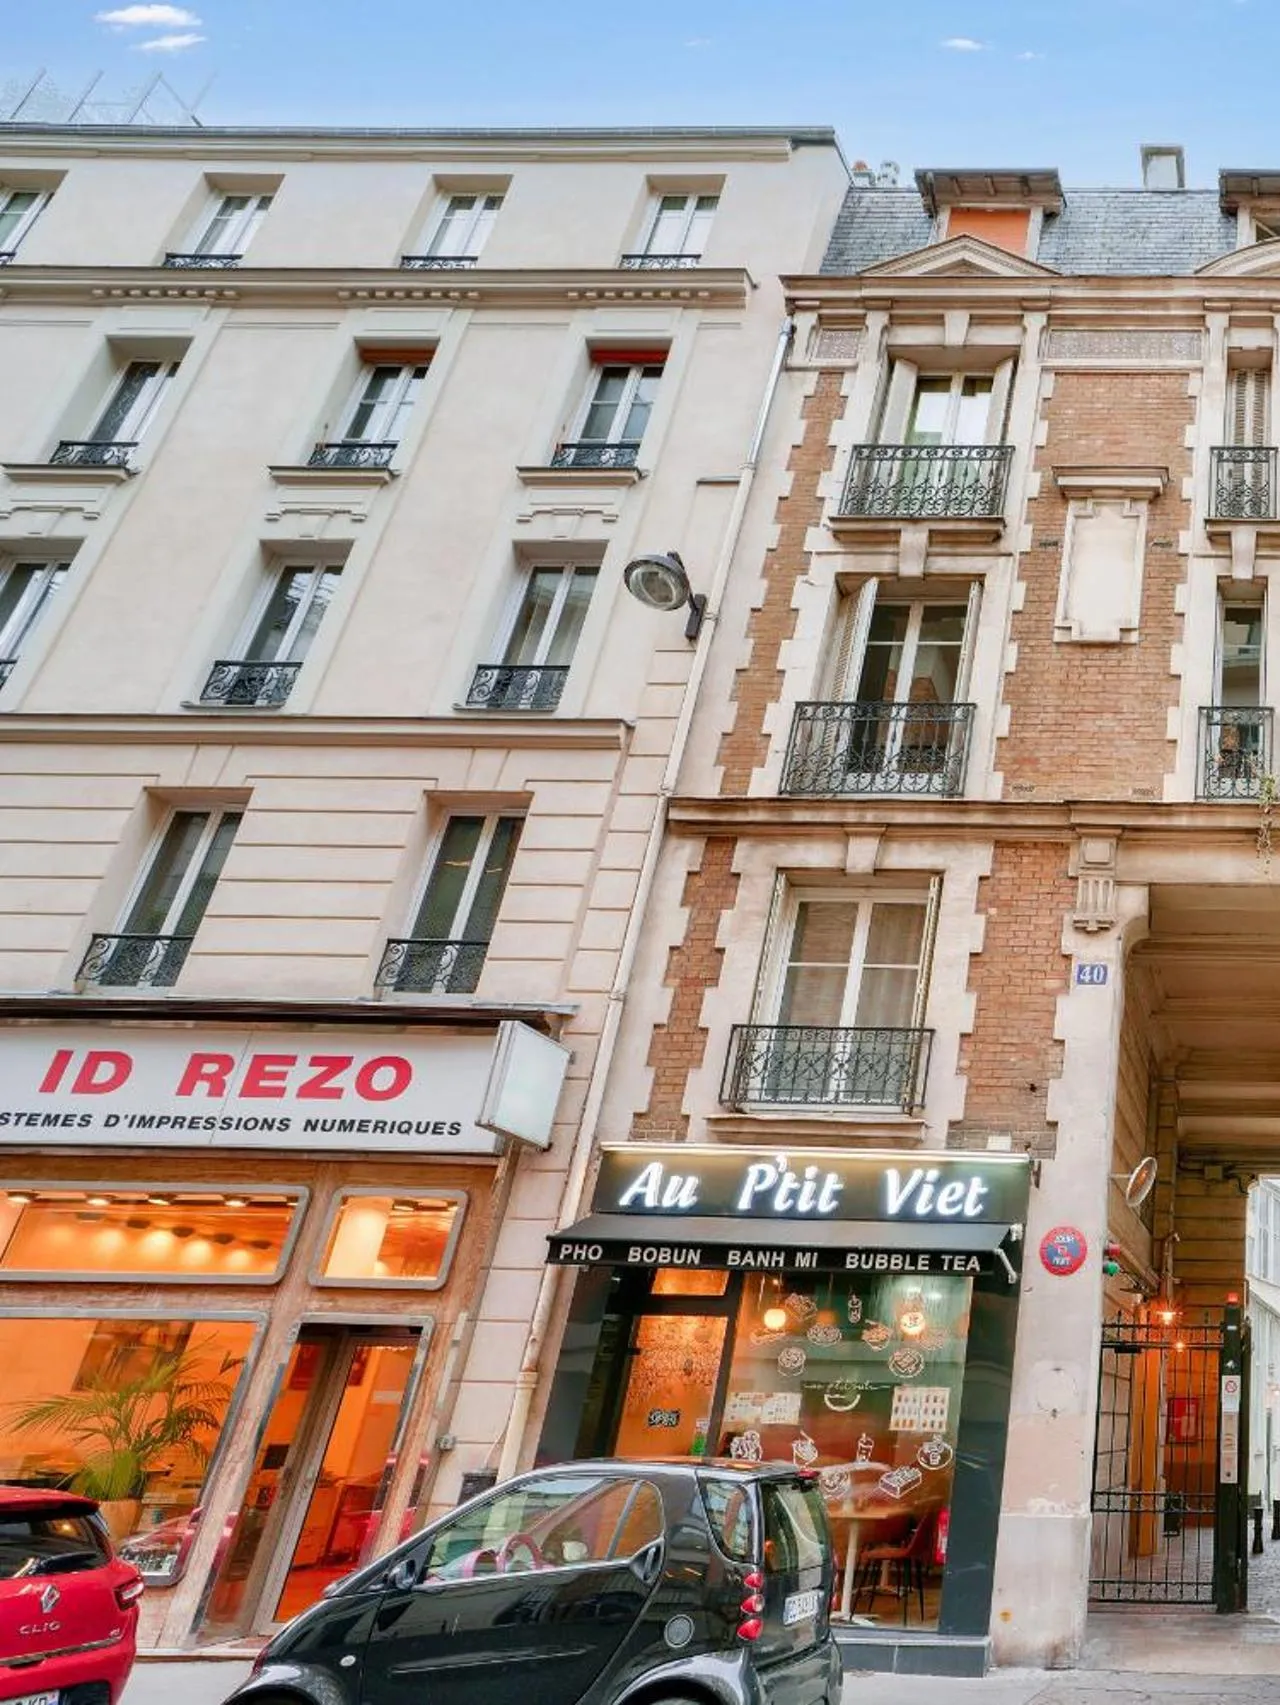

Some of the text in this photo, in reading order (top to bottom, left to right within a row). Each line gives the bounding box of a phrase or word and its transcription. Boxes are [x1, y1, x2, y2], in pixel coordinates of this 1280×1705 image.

[1079, 966, 1105, 983] 40
[38, 1049, 413, 1101] ID REZO
[104, 1113, 291, 1133] D'IMPRESSIONS
[303, 1118, 462, 1137] NUMERIQUES
[618, 1152, 988, 1217] Au P'tit Viet
[559, 1243, 981, 1272] PHO BOBUN BANH MI BUBBLE TEA
[19, 1620, 61, 1635] CLIO
